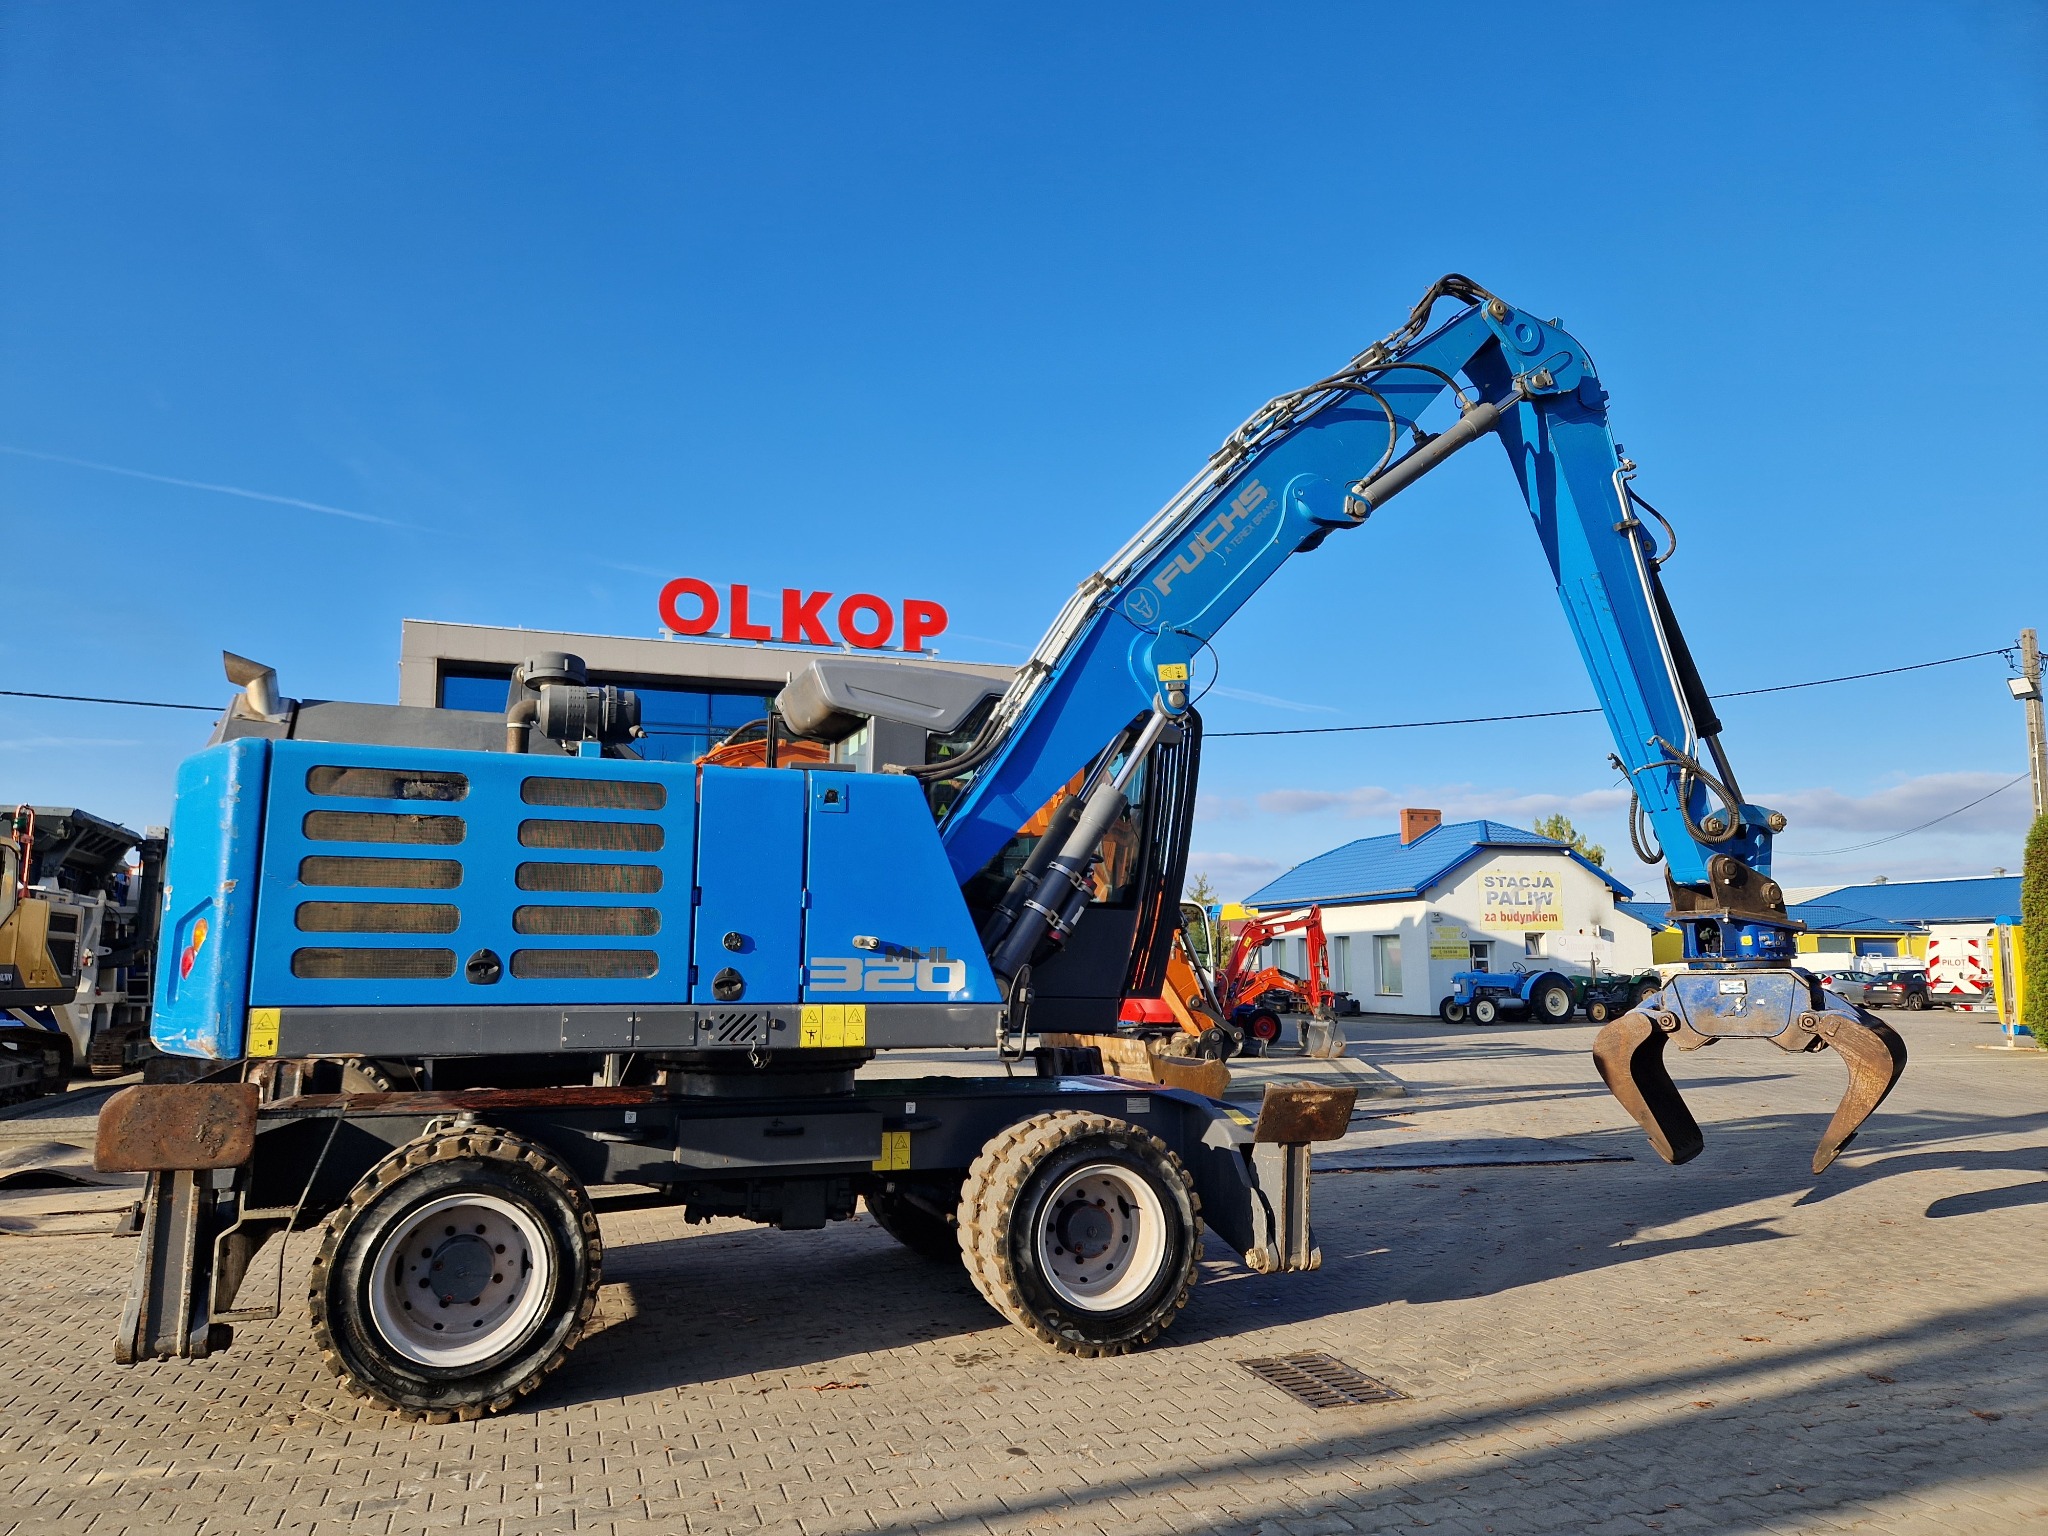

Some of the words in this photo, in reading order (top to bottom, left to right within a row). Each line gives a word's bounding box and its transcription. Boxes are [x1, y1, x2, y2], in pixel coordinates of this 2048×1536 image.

[1152, 479, 1269, 597] FUCHS
[1225, 546, 1233, 555] A
[1229, 523, 1255, 548] TEREX
[1253, 499, 1279, 526] BRAND
[658, 577, 949, 652] OLKOP
[1484, 876, 1554, 888] STACJA
[1486, 891, 1553, 906] PALIW
[1484, 913, 1497, 922] za
[1500, 911, 1558, 924] budynkiem
[884, 946, 958, 963] MHL
[809, 957, 966, 992] 320
